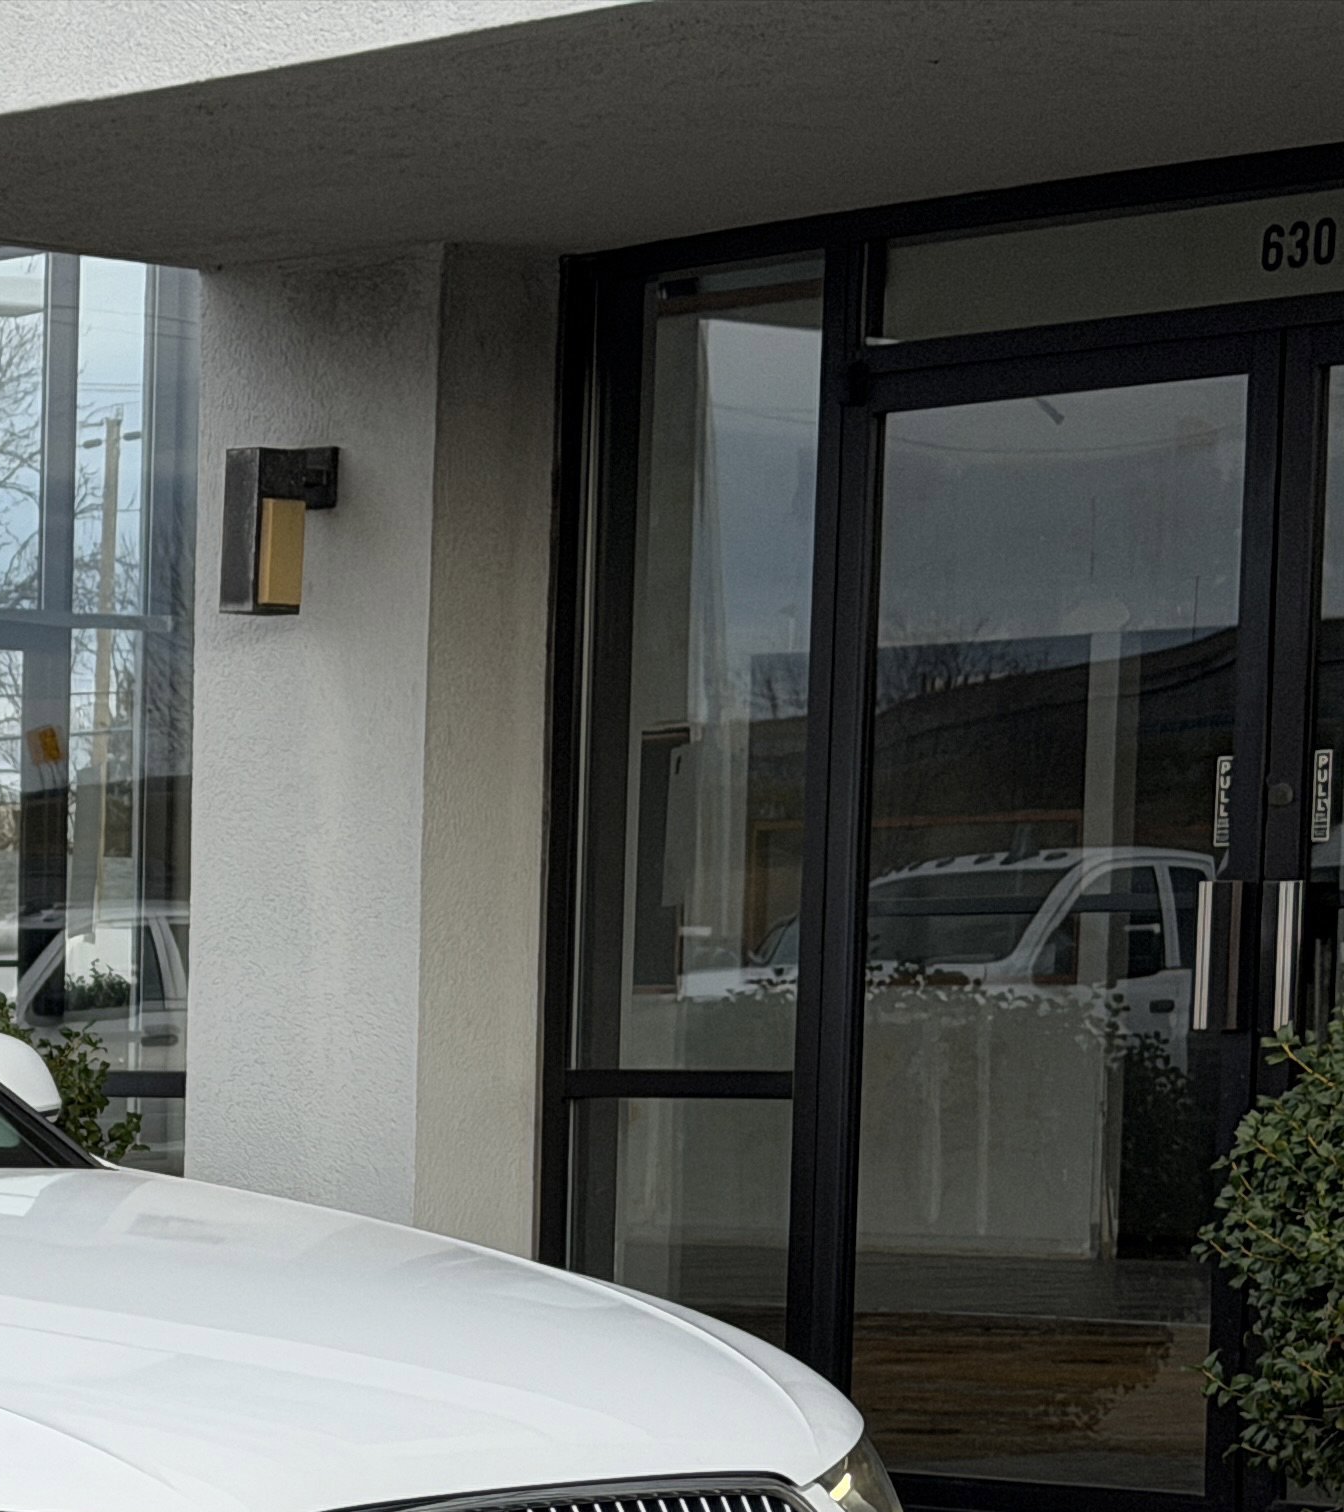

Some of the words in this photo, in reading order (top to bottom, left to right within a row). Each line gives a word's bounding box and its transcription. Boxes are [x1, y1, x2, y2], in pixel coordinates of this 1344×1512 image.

[1262, 217, 1337, 271] 630
[1219, 761, 1232, 817] PULL
[1316, 755, 1329, 813] PULL
